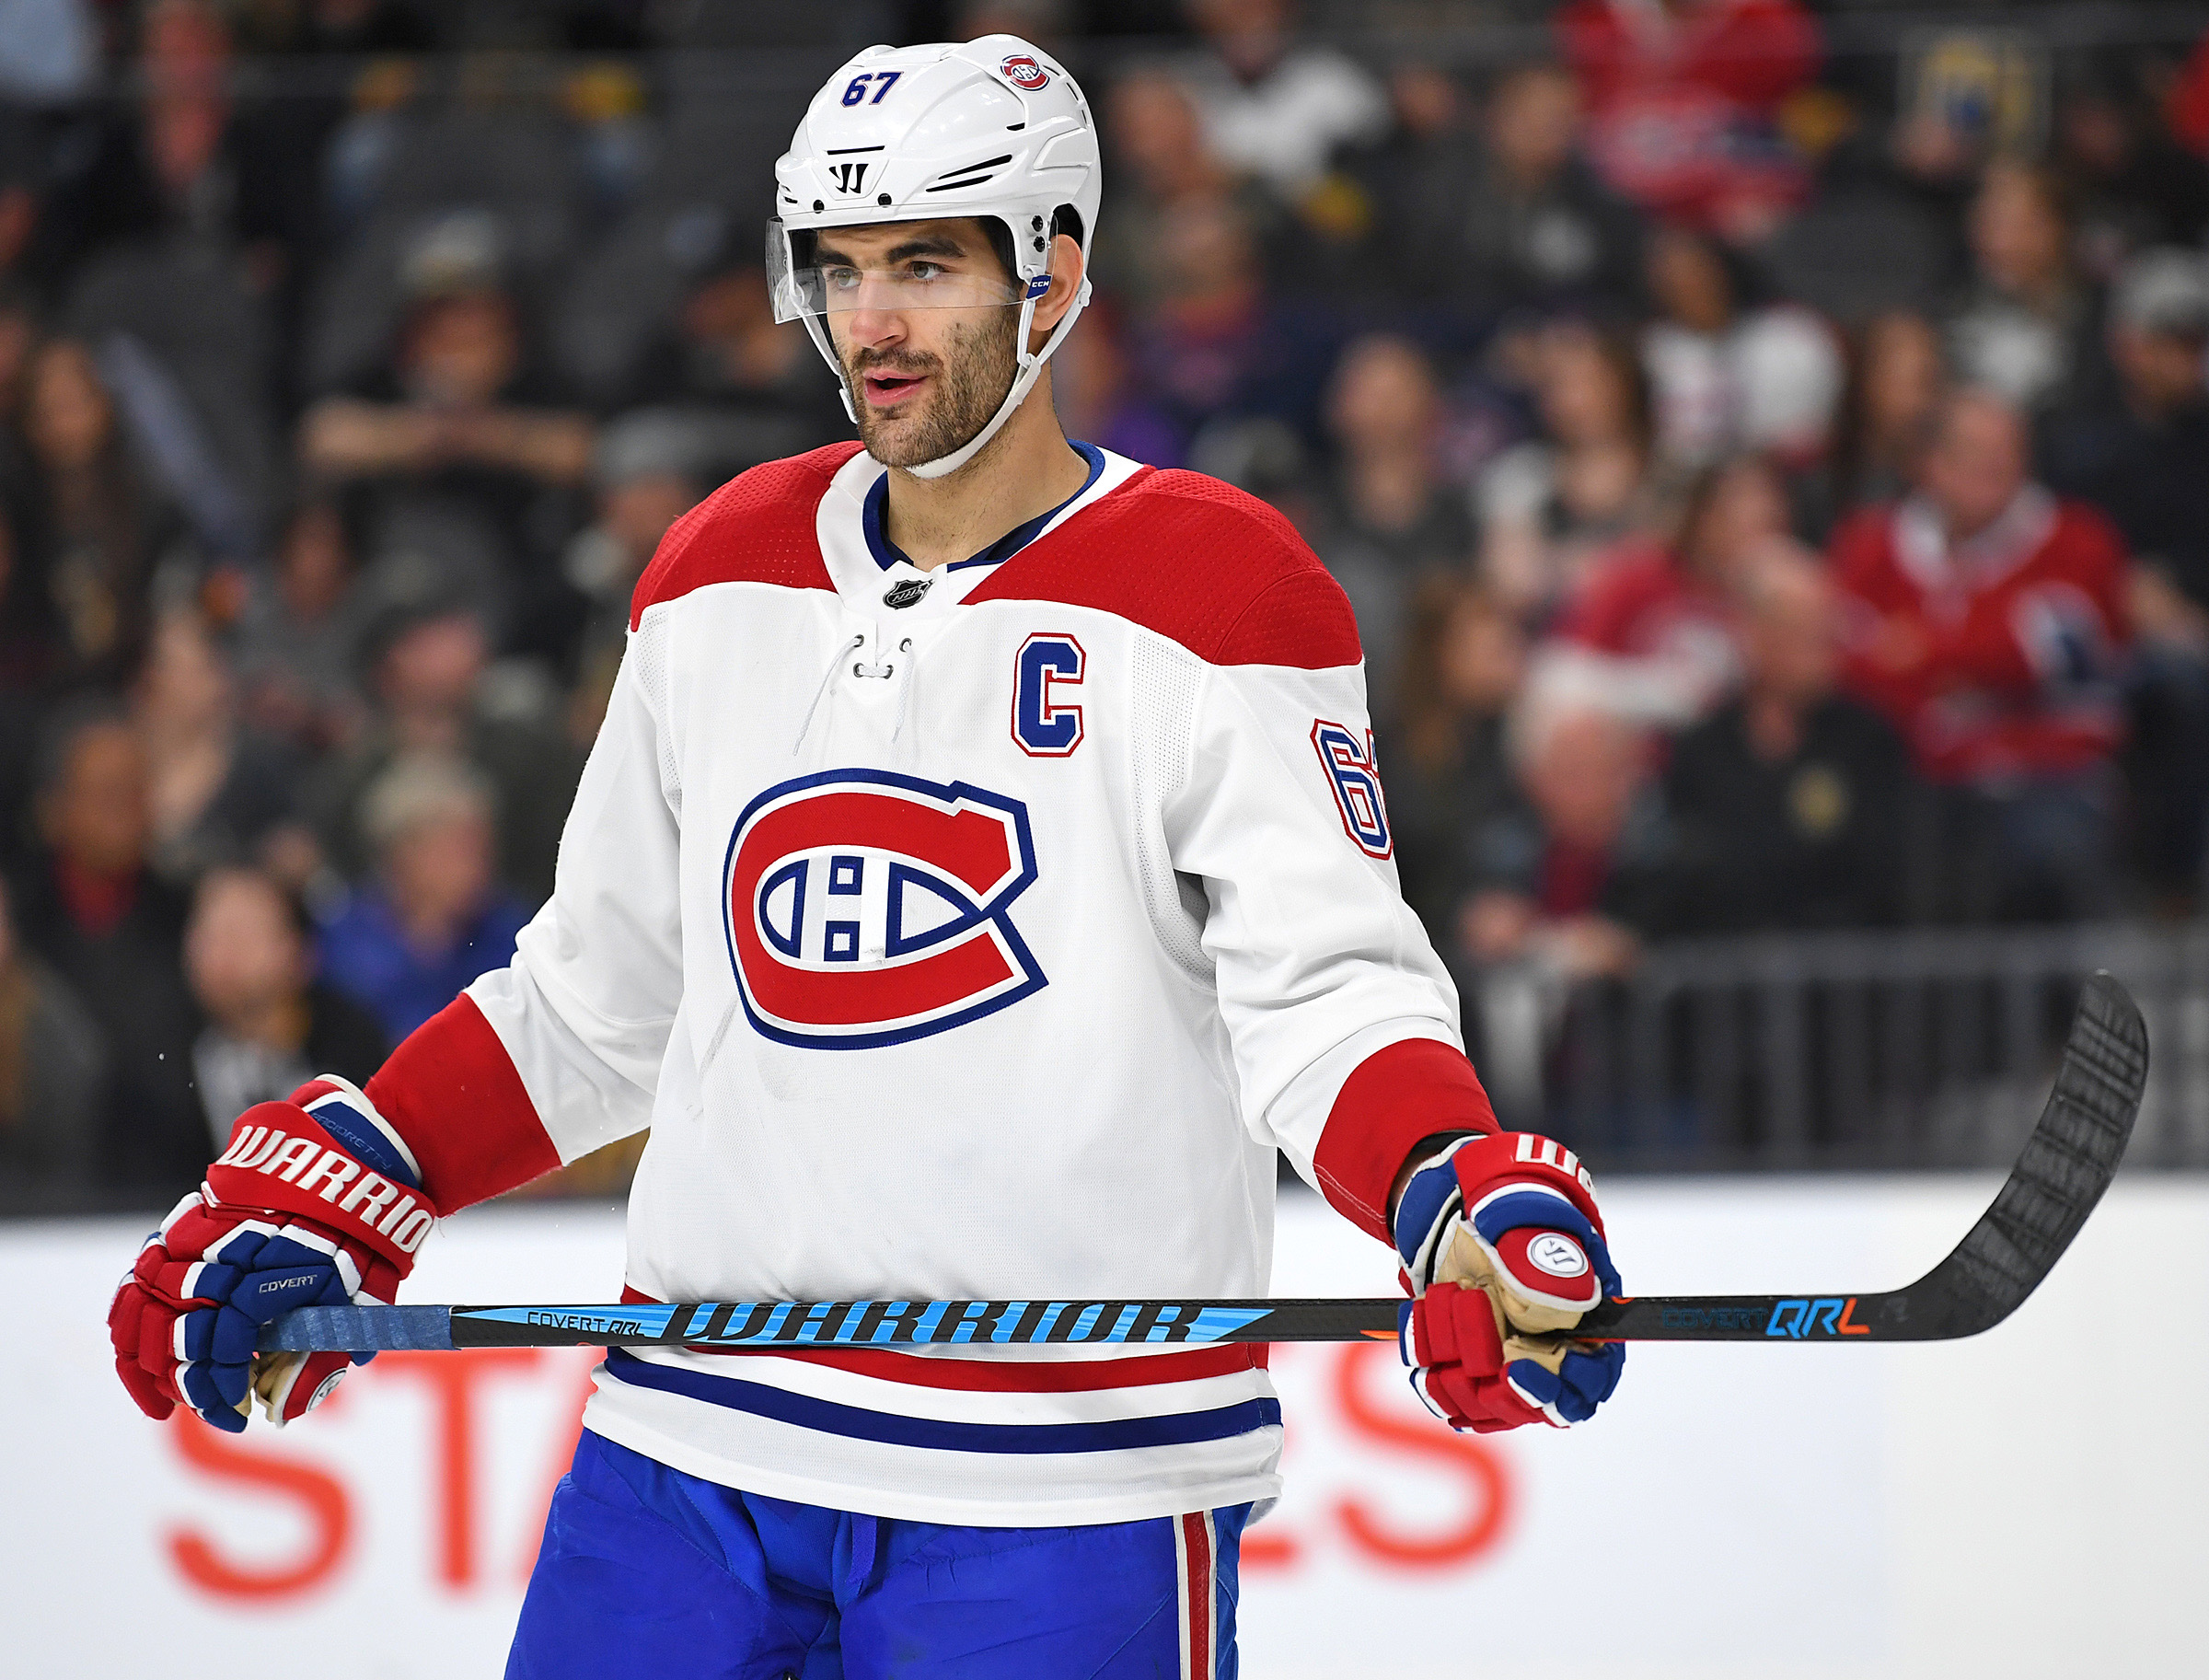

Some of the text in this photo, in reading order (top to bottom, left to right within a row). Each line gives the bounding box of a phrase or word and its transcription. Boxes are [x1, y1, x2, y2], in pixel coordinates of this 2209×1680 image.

[839, 71, 905, 109] 67
[1012, 632, 1087, 758] C
[214, 1125, 435, 1254] WARRIO
[259, 1274, 318, 1294] COVERT
[527, 1311, 606, 1333] COVERT
[665, 1301, 1200, 1343] WARRIOR
[1662, 1297, 1871, 1338] COVERT QRL
